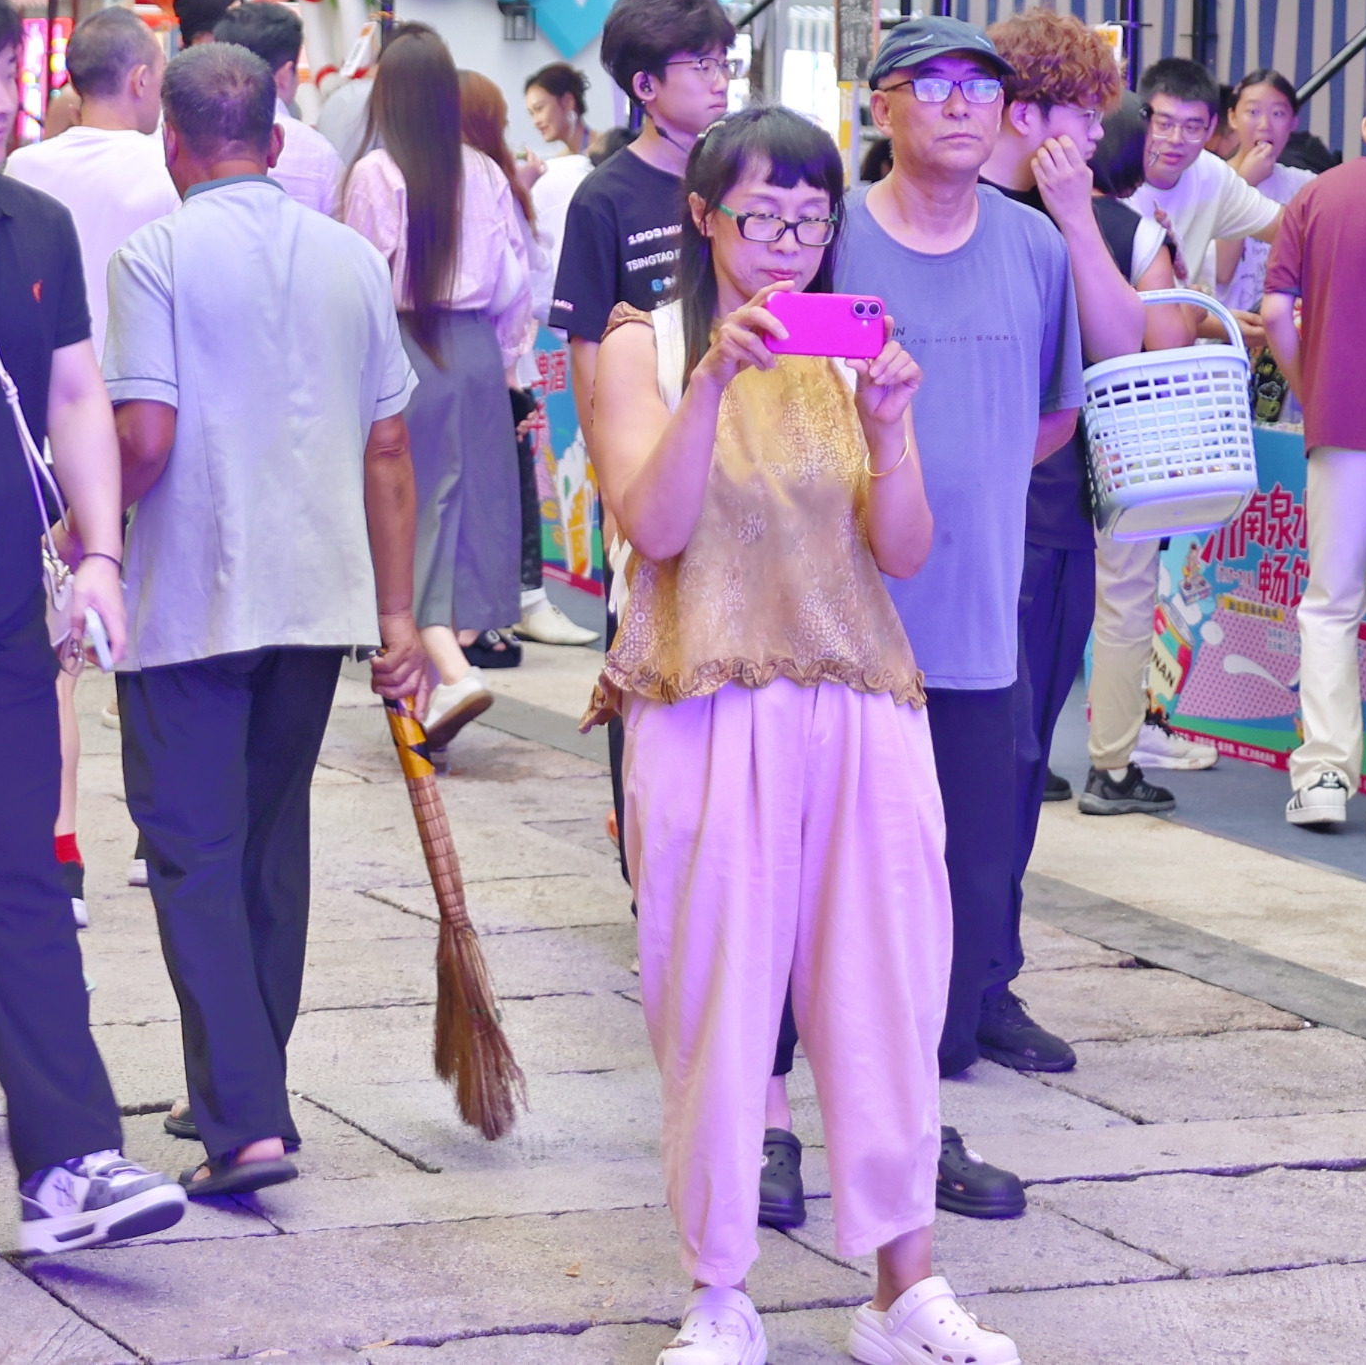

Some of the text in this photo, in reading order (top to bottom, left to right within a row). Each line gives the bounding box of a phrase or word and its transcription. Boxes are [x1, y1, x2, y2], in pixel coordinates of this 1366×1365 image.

[627, 225, 662, 246] 1903
[626, 250, 675, 272] TSINGTAO
[554, 298, 575, 311] MIX
